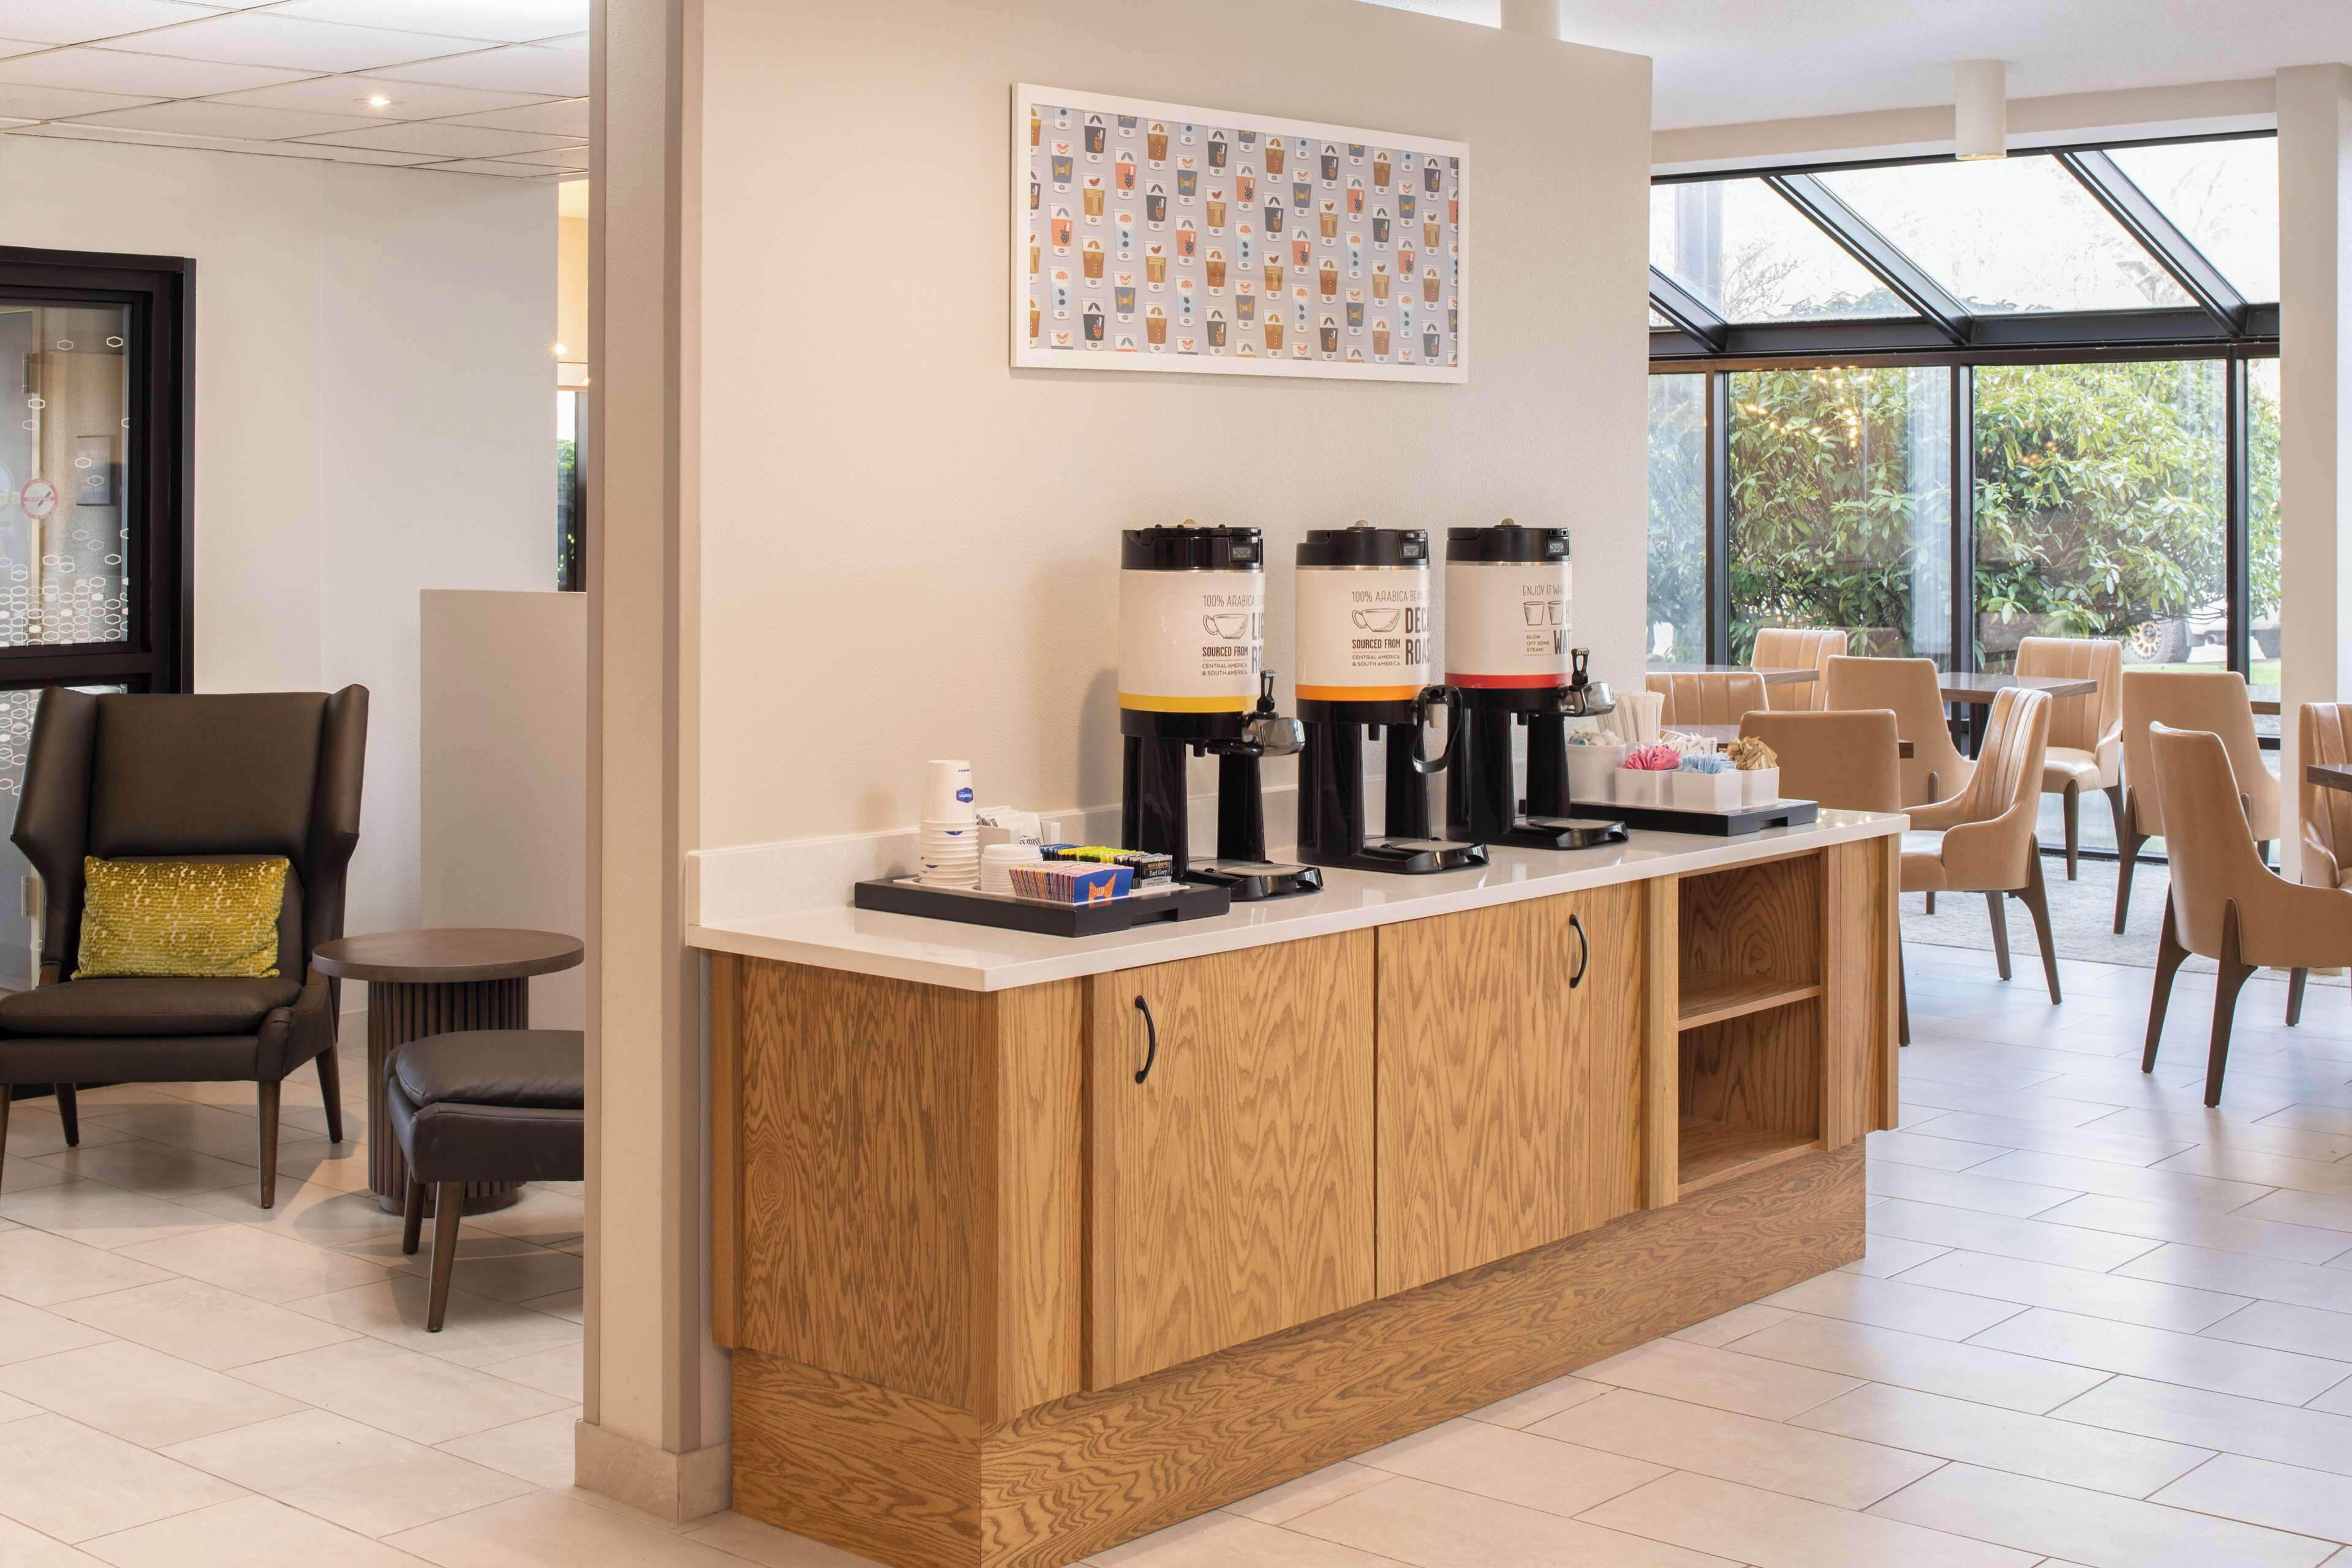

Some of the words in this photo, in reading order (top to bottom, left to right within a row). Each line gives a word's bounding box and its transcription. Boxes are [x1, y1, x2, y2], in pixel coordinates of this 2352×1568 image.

[1352, 591, 1373, 602] 100%
[1375, 590, 1408, 602] ARABICA
[1523, 585, 1544, 596] ENJOY
[1547, 585, 1552, 595] IT
[1203, 595, 1224, 607] 100%
[1226, 595, 1255, 607] ARABICA
[1352, 639, 1382, 649] SOURCED
[1384, 638, 1401, 649] FROM
[1202, 646, 1232, 657] SOURCED
[1234, 646, 1248, 657] FROM
